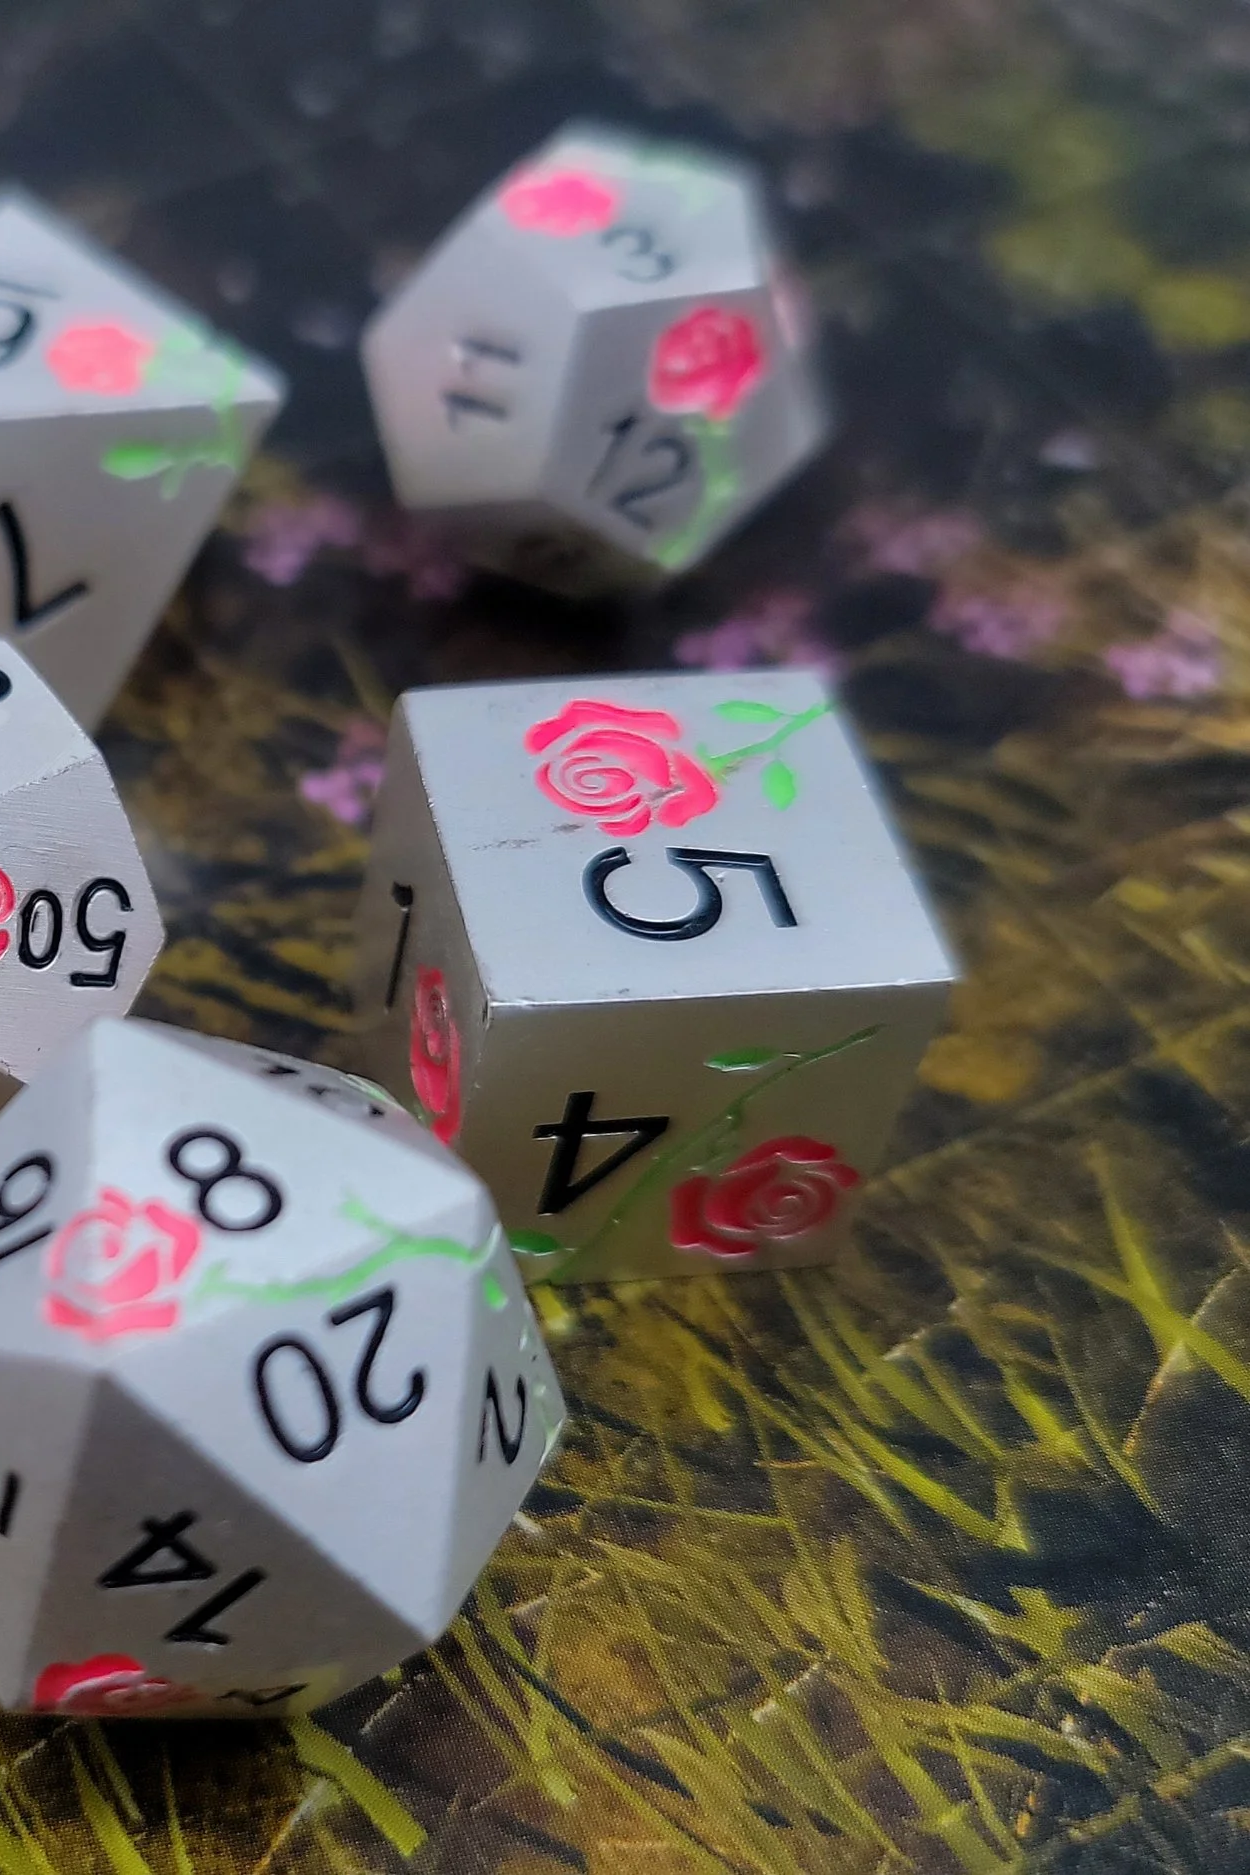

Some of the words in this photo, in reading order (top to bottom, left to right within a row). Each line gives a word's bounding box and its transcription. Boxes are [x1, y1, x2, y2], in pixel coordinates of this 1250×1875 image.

[586, 414, 692, 530] 12
[17, 876, 134, 989] 50
[385, 881, 413, 1013] 1
[582, 846, 798, 942] 5
[167, 1130, 283, 1232] 8
[532, 1091, 670, 1216] 4
[253, 1288, 425, 1465] 20
[98, 1510, 268, 1646] 14
